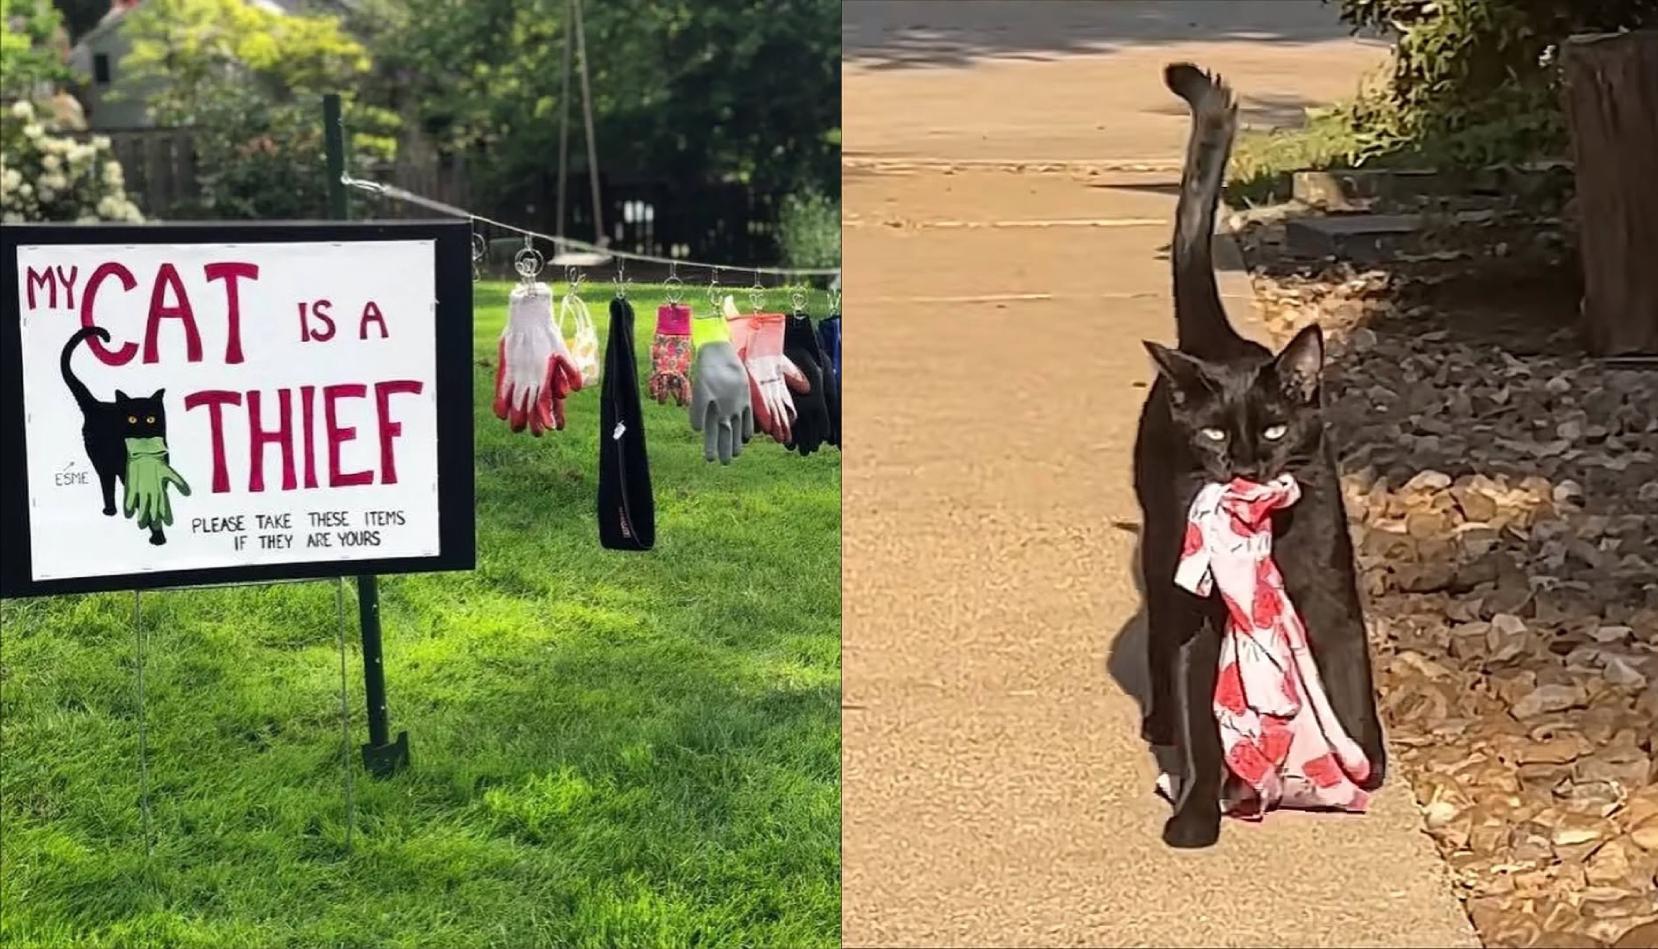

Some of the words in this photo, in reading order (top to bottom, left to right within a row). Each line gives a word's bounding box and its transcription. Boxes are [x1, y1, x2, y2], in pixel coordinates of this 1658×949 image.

[27, 265, 78, 310] MY
[80, 261, 260, 366] CAT
[298, 300, 336, 342] IS
[359, 301, 389, 340] A
[184, 380, 424, 494] THIEF
[55, 471, 89, 487] ESME
[191, 515, 246, 534] PLEASE
[255, 513, 292, 531] TAKE
[308, 511, 350, 528] THESE
[364, 510, 406, 526] ITEMS
[234, 535, 247, 551] IF
[258, 533, 294, 550] THEY
[306, 532, 332, 548] ARE
[337, 530, 381, 547] YOURS
